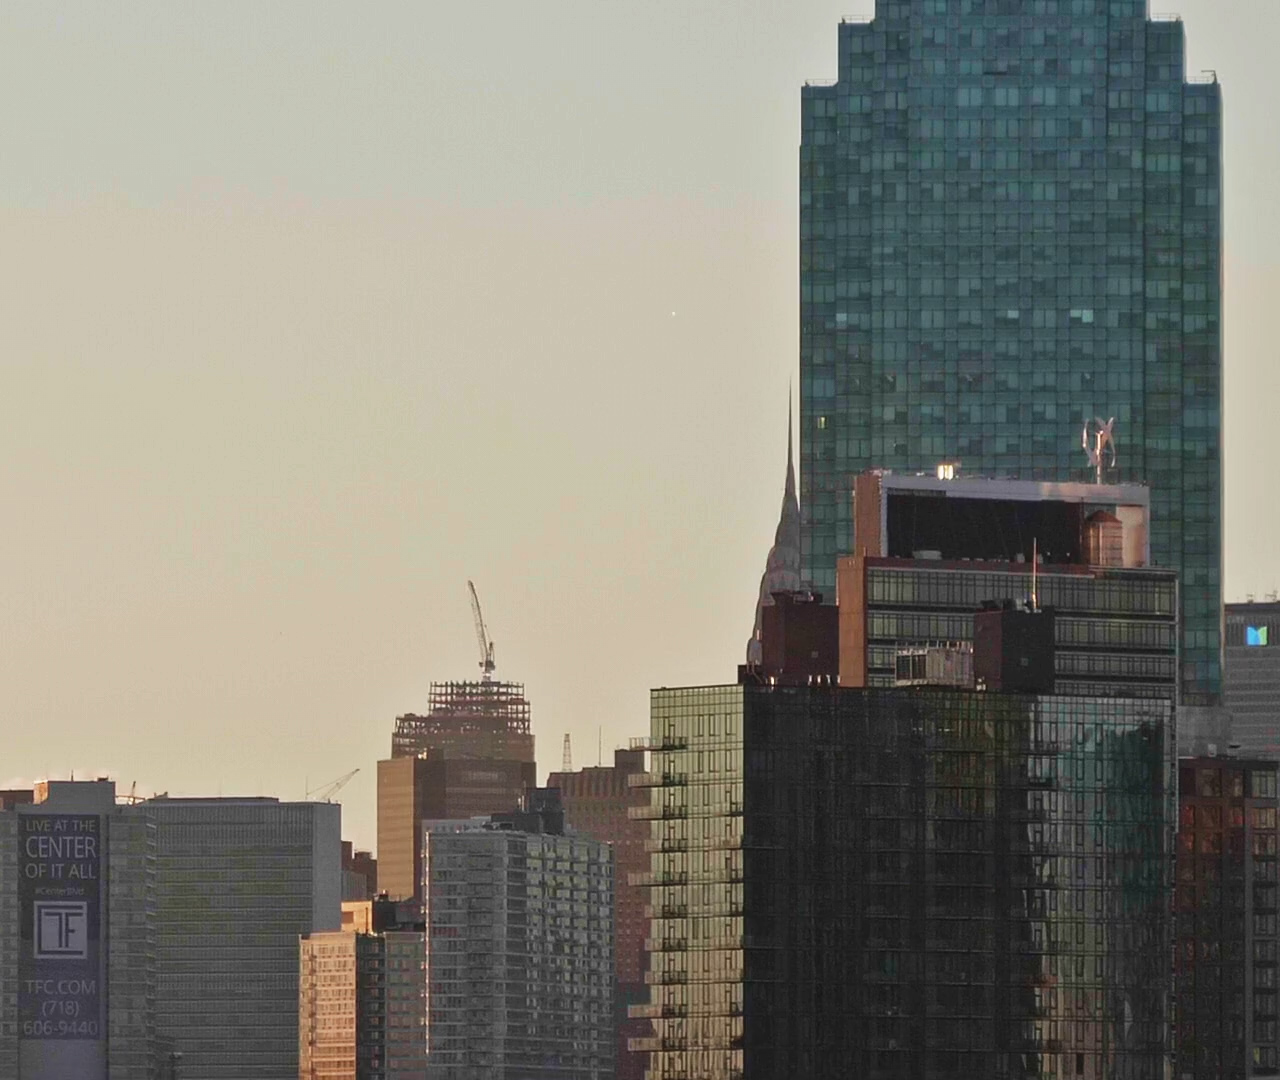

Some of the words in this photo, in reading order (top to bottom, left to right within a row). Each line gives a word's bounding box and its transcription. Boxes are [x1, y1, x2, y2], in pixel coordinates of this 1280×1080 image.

[26, 820, 51, 832] LIVE
[54, 820, 69, 831] AT
[72, 820, 96, 832] THE
[25, 836, 96, 858] CENTER
[25, 863, 47, 879] OF
[51, 864, 65, 878] IT
[68, 864, 97, 879] ALL
[24, 979, 96, 995] TFC.COM
[42, 1000, 80, 1018] (718)
[23, 1020, 98, 1036] 606-9440
